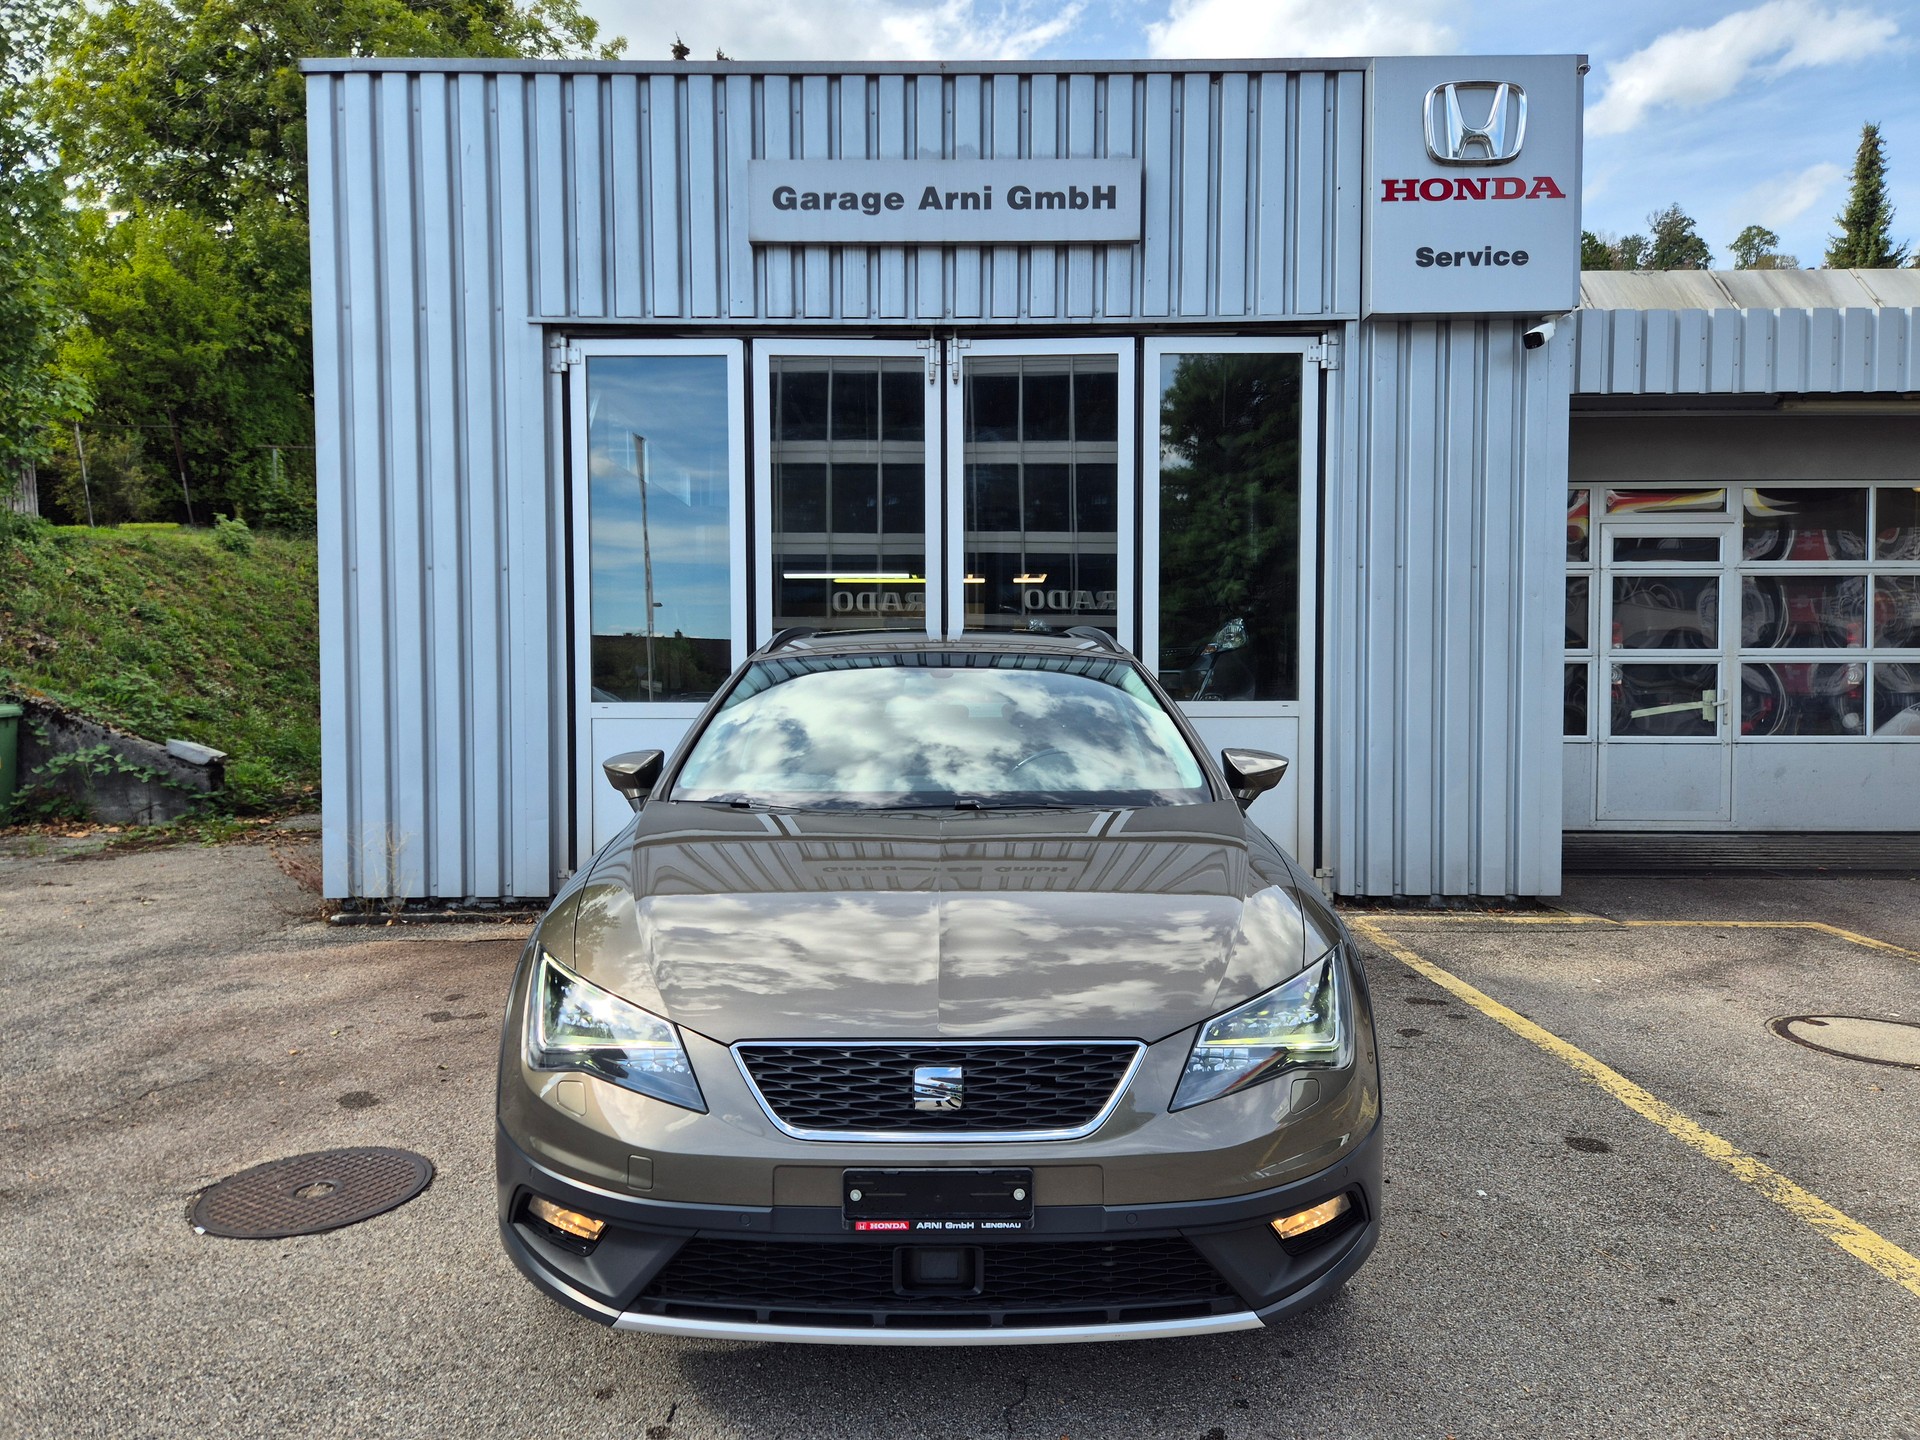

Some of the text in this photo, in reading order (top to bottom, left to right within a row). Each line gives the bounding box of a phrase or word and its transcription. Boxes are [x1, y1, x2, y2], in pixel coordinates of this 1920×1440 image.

[772, 185, 1117, 216] Garage Arni GmbH
[1381, 176, 1566, 202] HONDA
[1415, 246, 1530, 267] Service
[869, 1222, 907, 1230] HONDA
[916, 1221, 942, 1230] ARNI
[945, 1221, 975, 1230] GmbH
